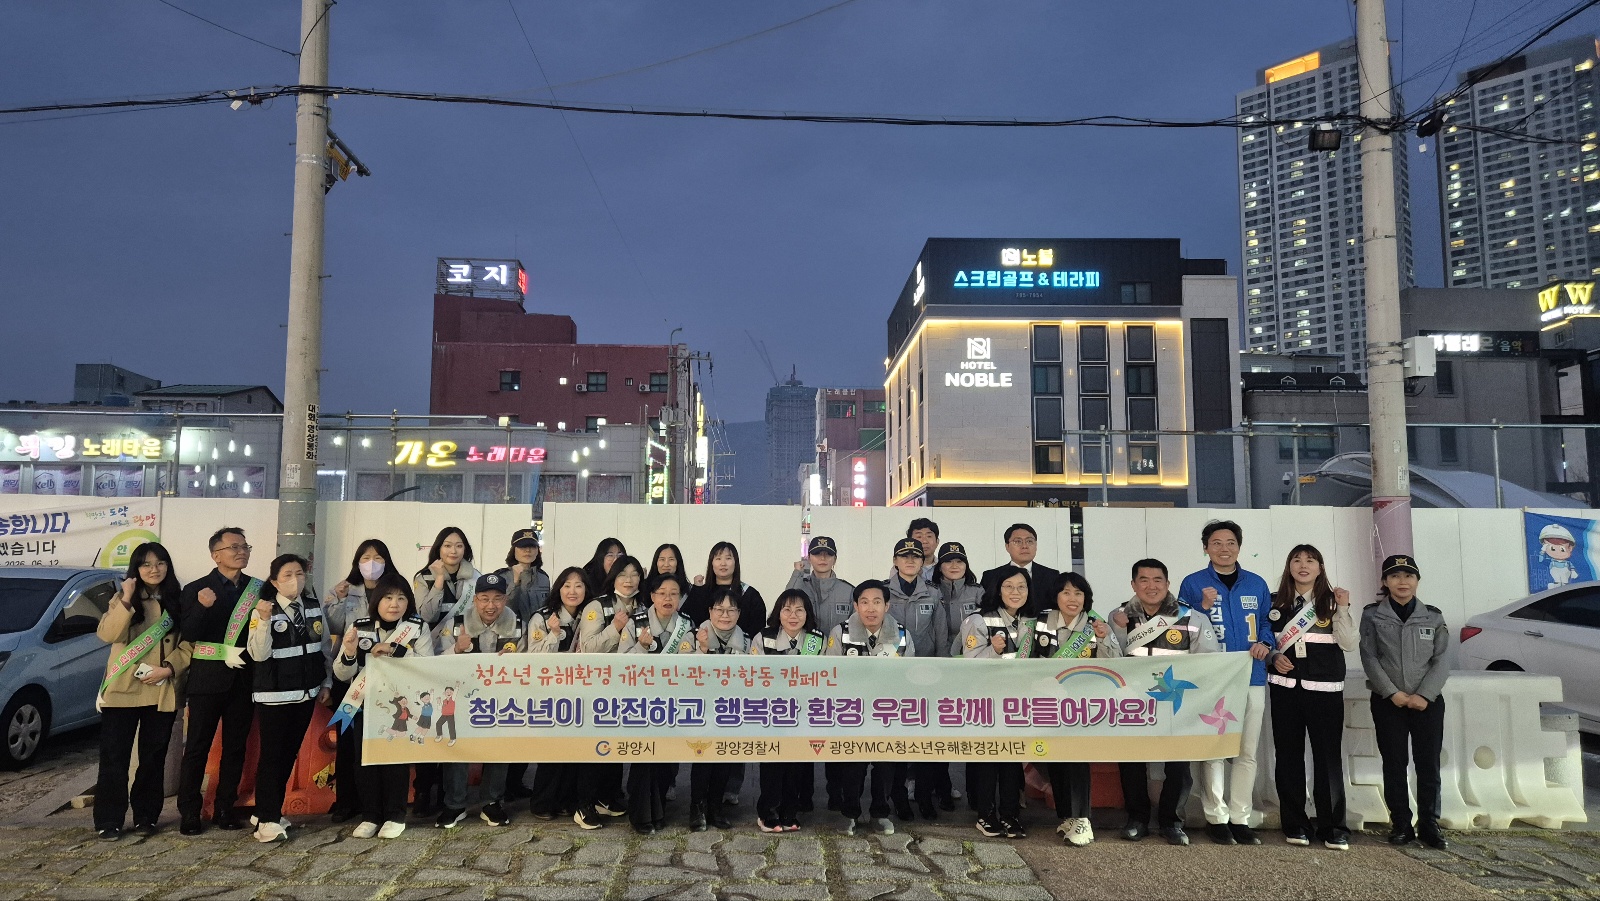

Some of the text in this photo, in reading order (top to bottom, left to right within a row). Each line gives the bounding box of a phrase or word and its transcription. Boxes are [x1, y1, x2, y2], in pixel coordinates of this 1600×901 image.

[1022, 248, 1053, 267] 노블
[447, 264, 507, 285] 코지
[954, 270, 1100, 287] 스크린골프 & 테라피
[1539, 283, 1560, 312] W
[1564, 282, 1595, 305] W
[960, 361, 997, 370] HOTEL
[945, 372, 1013, 387] NOBLE
[83, 437, 161, 457] 노래타운
[387, 441, 545, 467] 가온 노래타운
[652, 473, 664, 497] 가온
[109, 506, 128, 517] 도약
[1245, 613, 1258, 642] 1
[476, 664, 531, 686] 청소년
[537, 664, 612, 687] 유해환경
[618, 664, 655, 687] 개선
[780, 665, 838, 687] 캠페인
[469, 697, 1157, 727] 청소년이 안전하고 행복한 환경 우리 함께 만들어가요!
[616, 741, 655, 756] 광양시
[715, 740, 780, 755] 광양경찰서
[830, 740, 1026, 756] 광양YMCA청소년유해환경감시단
